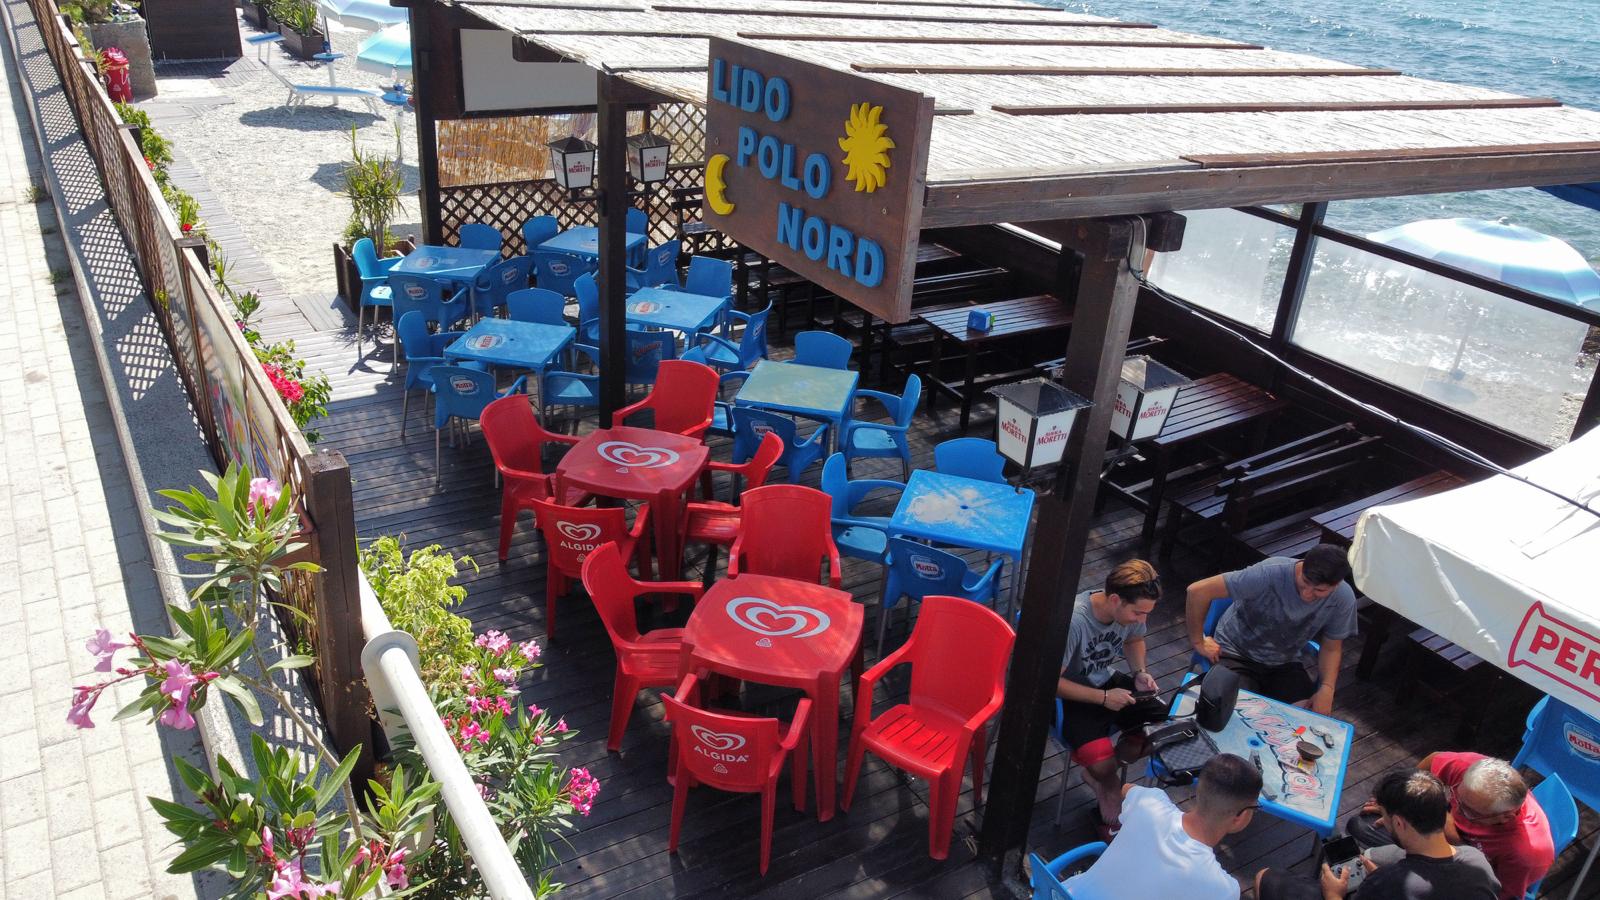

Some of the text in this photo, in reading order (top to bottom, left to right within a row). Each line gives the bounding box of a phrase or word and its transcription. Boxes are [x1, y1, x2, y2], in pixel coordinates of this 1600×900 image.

[713, 57, 791, 122] LIDO
[737, 126, 831, 199] POLO
[777, 202, 885, 287] NORD
[1140, 408, 1167, 420] MORETTI
[1001, 421, 1027, 444] MORETTI
[1037, 432, 1067, 446] MORETTI
[1529, 625, 1600, 686] PER
[694, 745, 748, 762] ALGIDA
[1568, 733, 1600, 753] Motta
